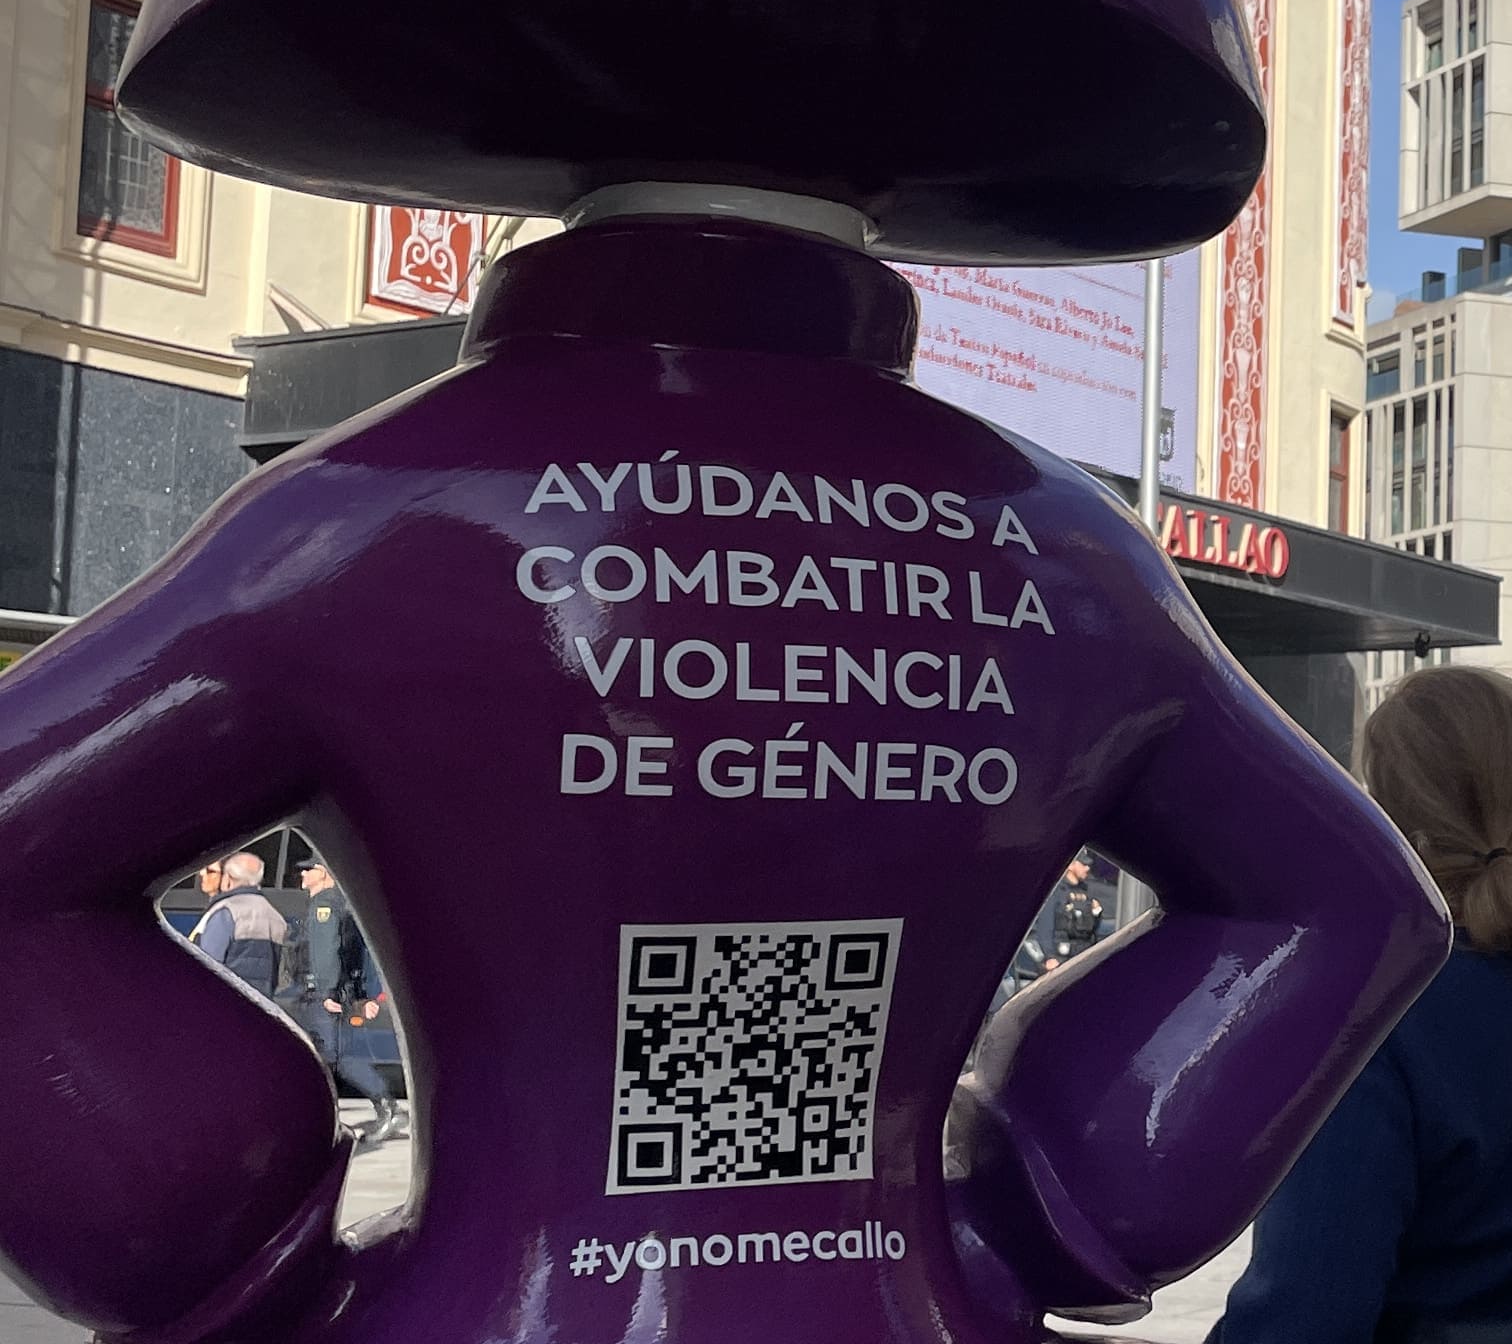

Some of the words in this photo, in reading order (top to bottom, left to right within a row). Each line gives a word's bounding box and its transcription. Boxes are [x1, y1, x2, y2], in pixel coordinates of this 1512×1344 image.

[524, 450, 975, 540] AYÚDANOS
[992, 505, 1039, 555] A
[1157, 502, 1290, 578] ALLAO
[515, 545, 953, 620] COMBATIR
[969, 571, 1056, 635] LA
[574, 636, 1015, 714] VIOLENCIA
[560, 734, 674, 796] DE
[697, 722, 1019, 805] GÉNERO
[569, 1220, 906, 1283] #yonomecallo
